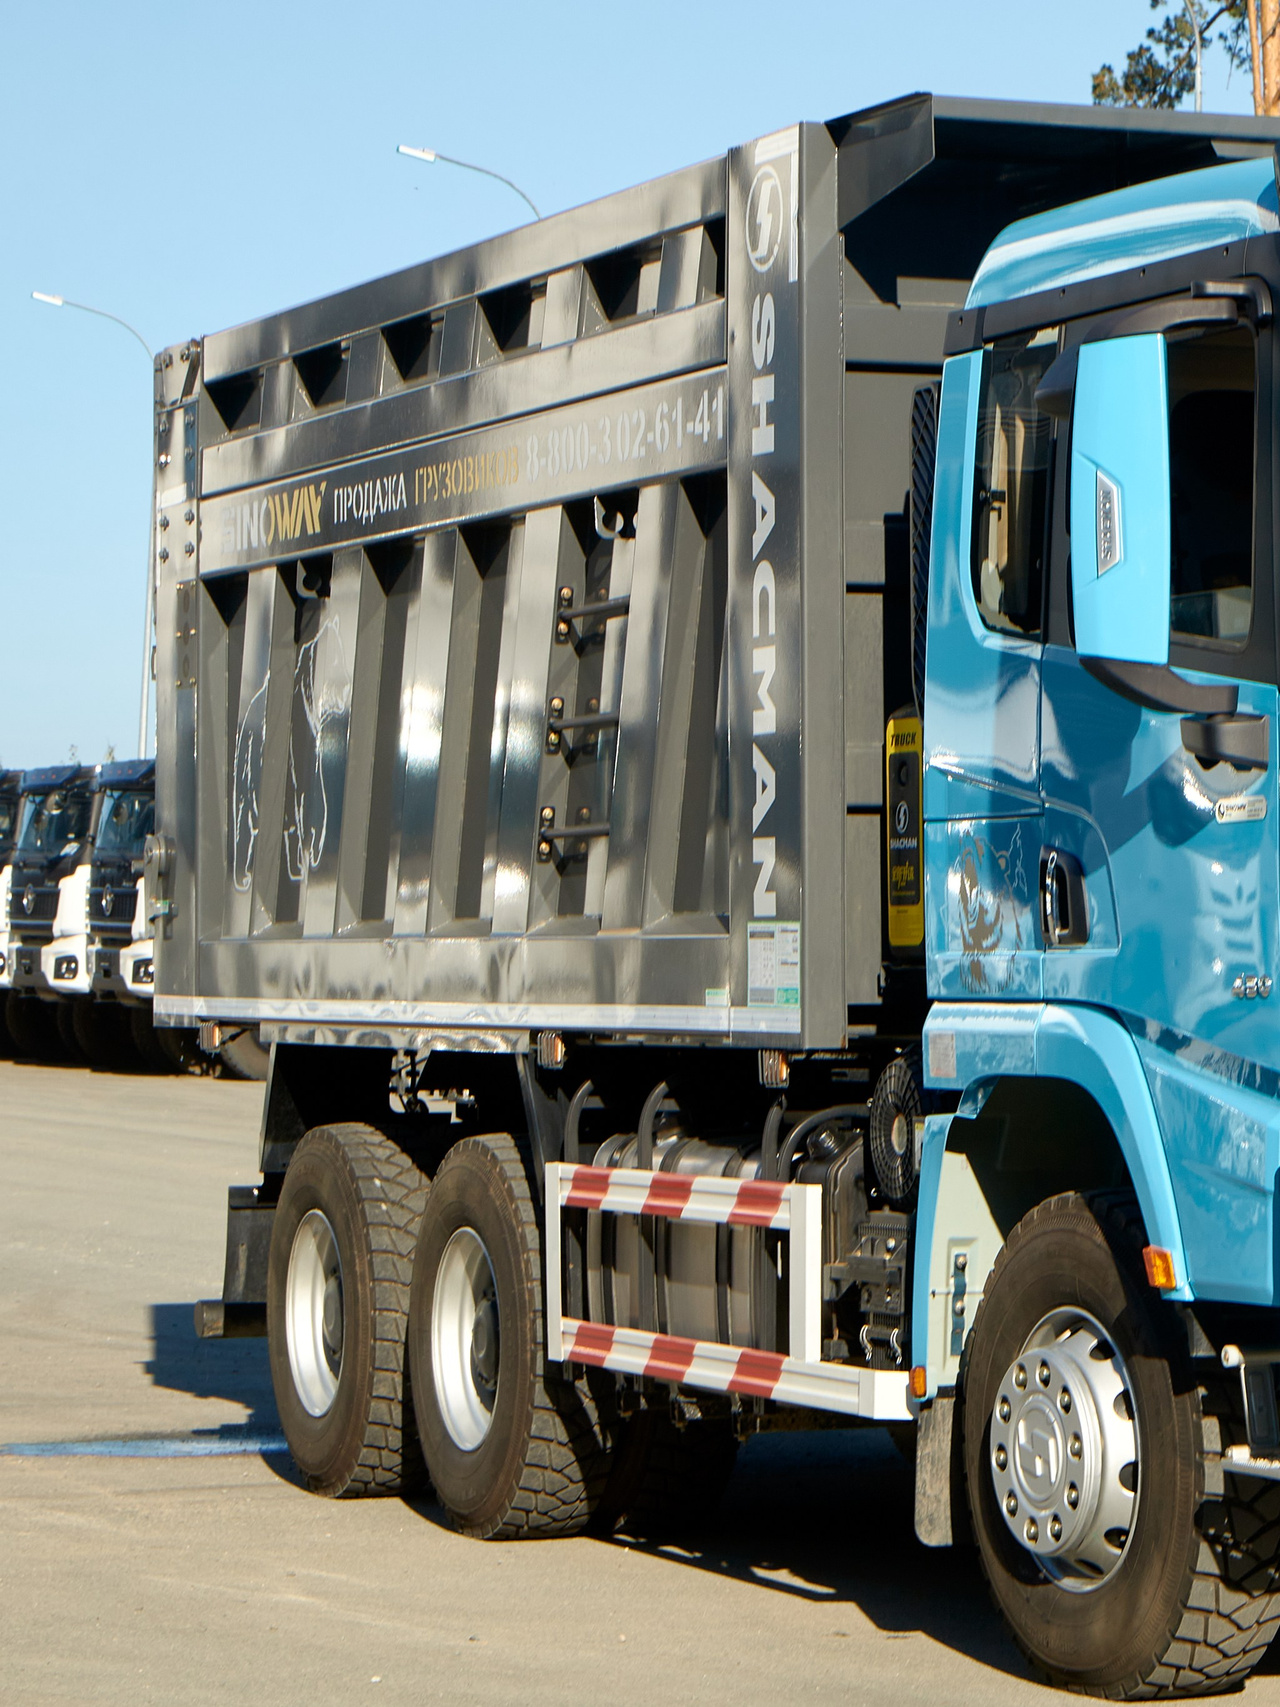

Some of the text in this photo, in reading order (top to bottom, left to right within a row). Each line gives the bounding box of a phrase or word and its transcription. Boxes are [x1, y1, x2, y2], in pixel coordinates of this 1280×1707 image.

[333, 472, 407, 525] ПРОДАЖА
[415, 446, 519, 505] ГРУЗОВИКОВ
[751, 291, 777, 918] SHACMAN
[891, 731, 917, 747] TRUCK
